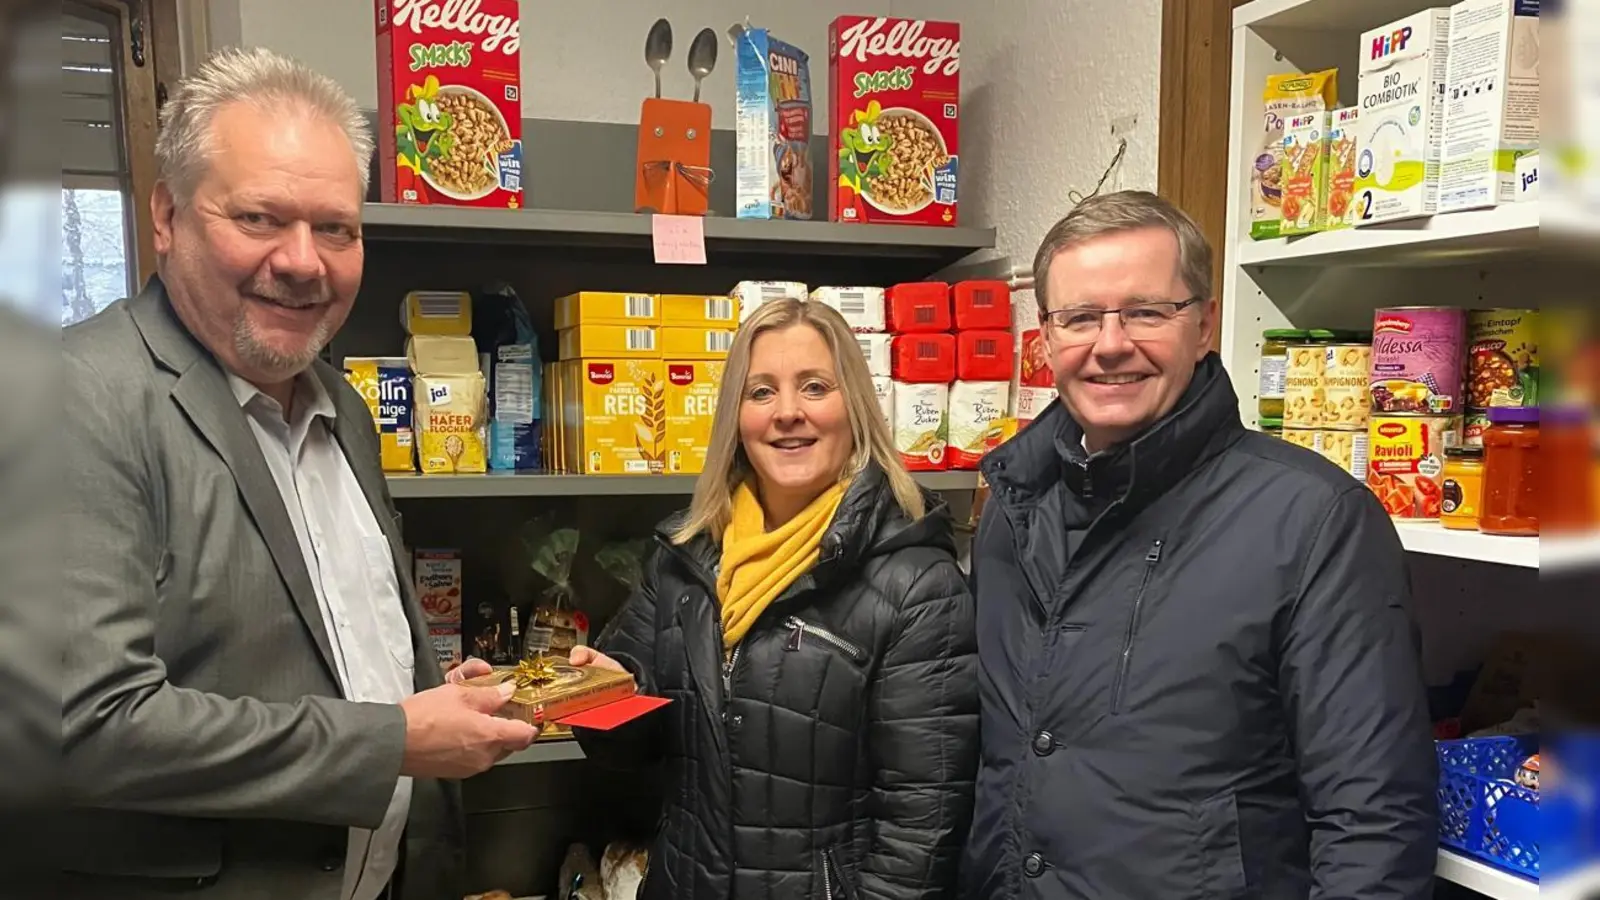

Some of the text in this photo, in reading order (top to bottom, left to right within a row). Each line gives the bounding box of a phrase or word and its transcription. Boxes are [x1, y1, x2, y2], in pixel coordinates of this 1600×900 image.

[1371, 26, 1412, 61] HiPP
[769, 53, 798, 75] CINI
[1383, 72, 1401, 88] BIO
[1363, 81, 1418, 109] COMBIOTIK
[1291, 115, 1315, 128] HiPP
[500, 159, 520, 168] win
[936, 174, 957, 182] win
[1522, 168, 1538, 192] ja!
[1362, 191, 1373, 219] 2
[430, 387, 447, 402] ja!
[604, 394, 647, 416] REIS
[430, 415, 472, 426] HAFER
[430, 425, 473, 433] FLOCKEN
[1374, 444, 1413, 457] Ravioli
